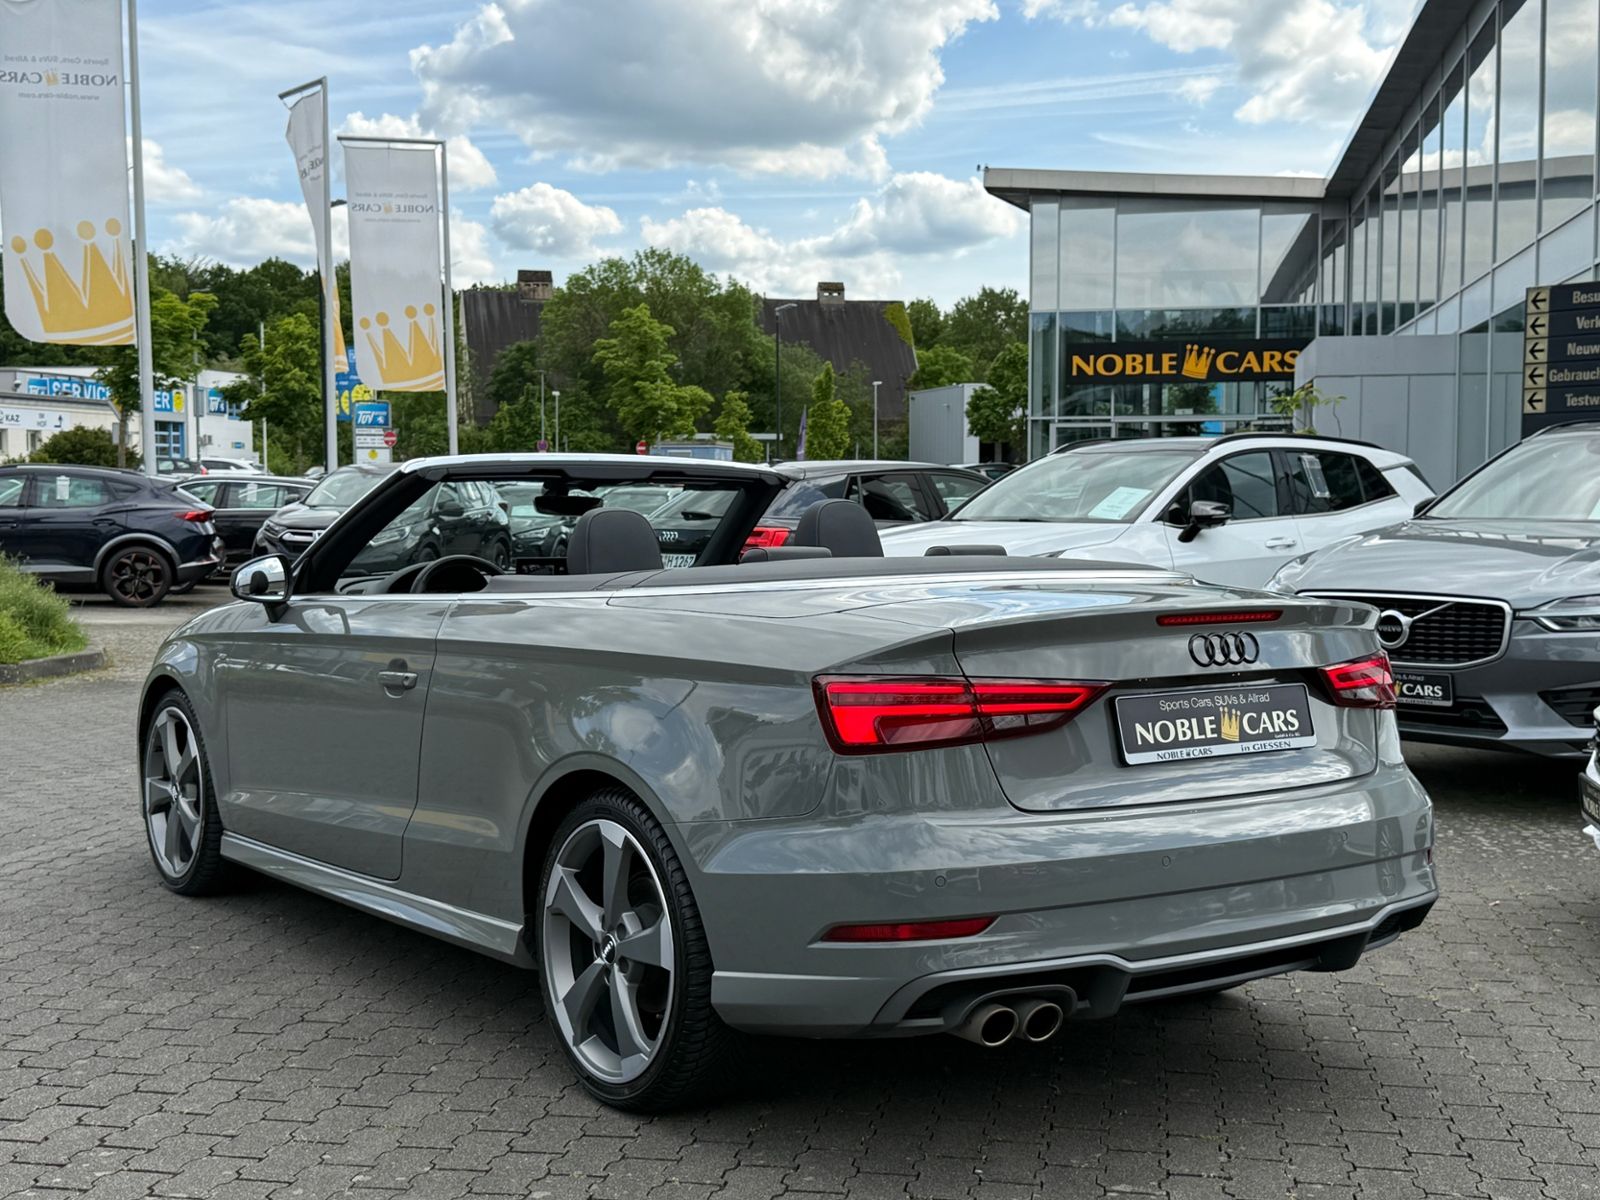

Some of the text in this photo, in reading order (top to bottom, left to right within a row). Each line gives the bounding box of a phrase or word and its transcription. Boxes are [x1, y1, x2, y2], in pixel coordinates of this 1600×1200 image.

[1071, 350, 1300, 377] NOBLE CARS
[5, 414, 20, 423] KAZ
[1378, 625, 1402, 633] VOLVO
[1402, 683, 1443, 697] CARS
[1159, 692, 1270, 712] Sports Cars, SUVs & Allrad
[1135, 709, 1300, 746] NOBLE CARS
[1240, 740, 1292, 752] in GIESSEN
[1157, 748, 1213, 761] NOBLE CARS
